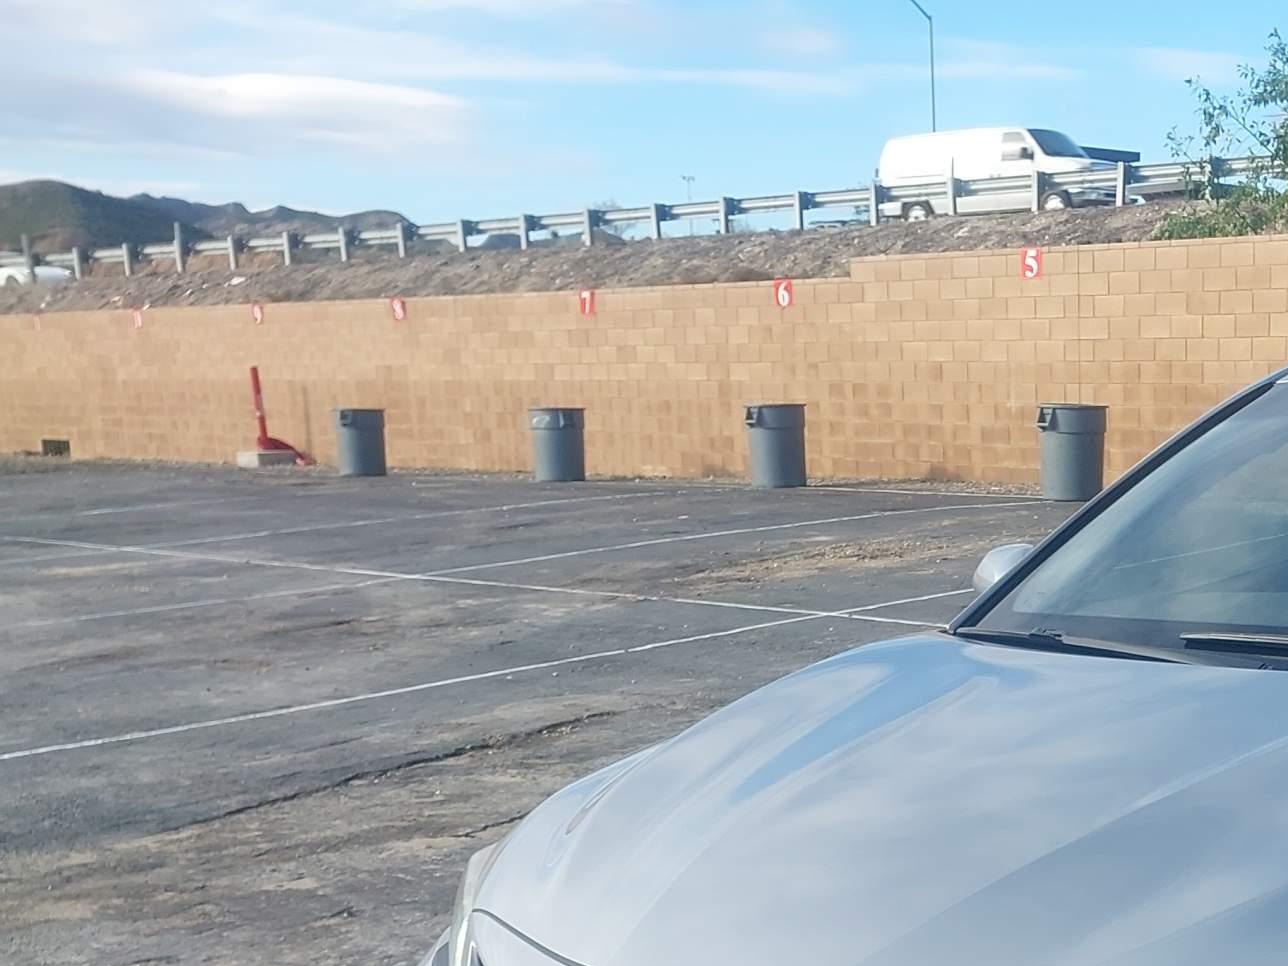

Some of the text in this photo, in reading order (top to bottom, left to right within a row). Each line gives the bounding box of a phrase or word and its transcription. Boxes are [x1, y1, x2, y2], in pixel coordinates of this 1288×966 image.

[1024, 250, 1039, 278] 5
[580, 290, 591, 314] 7
[777, 281, 790, 307] 6
